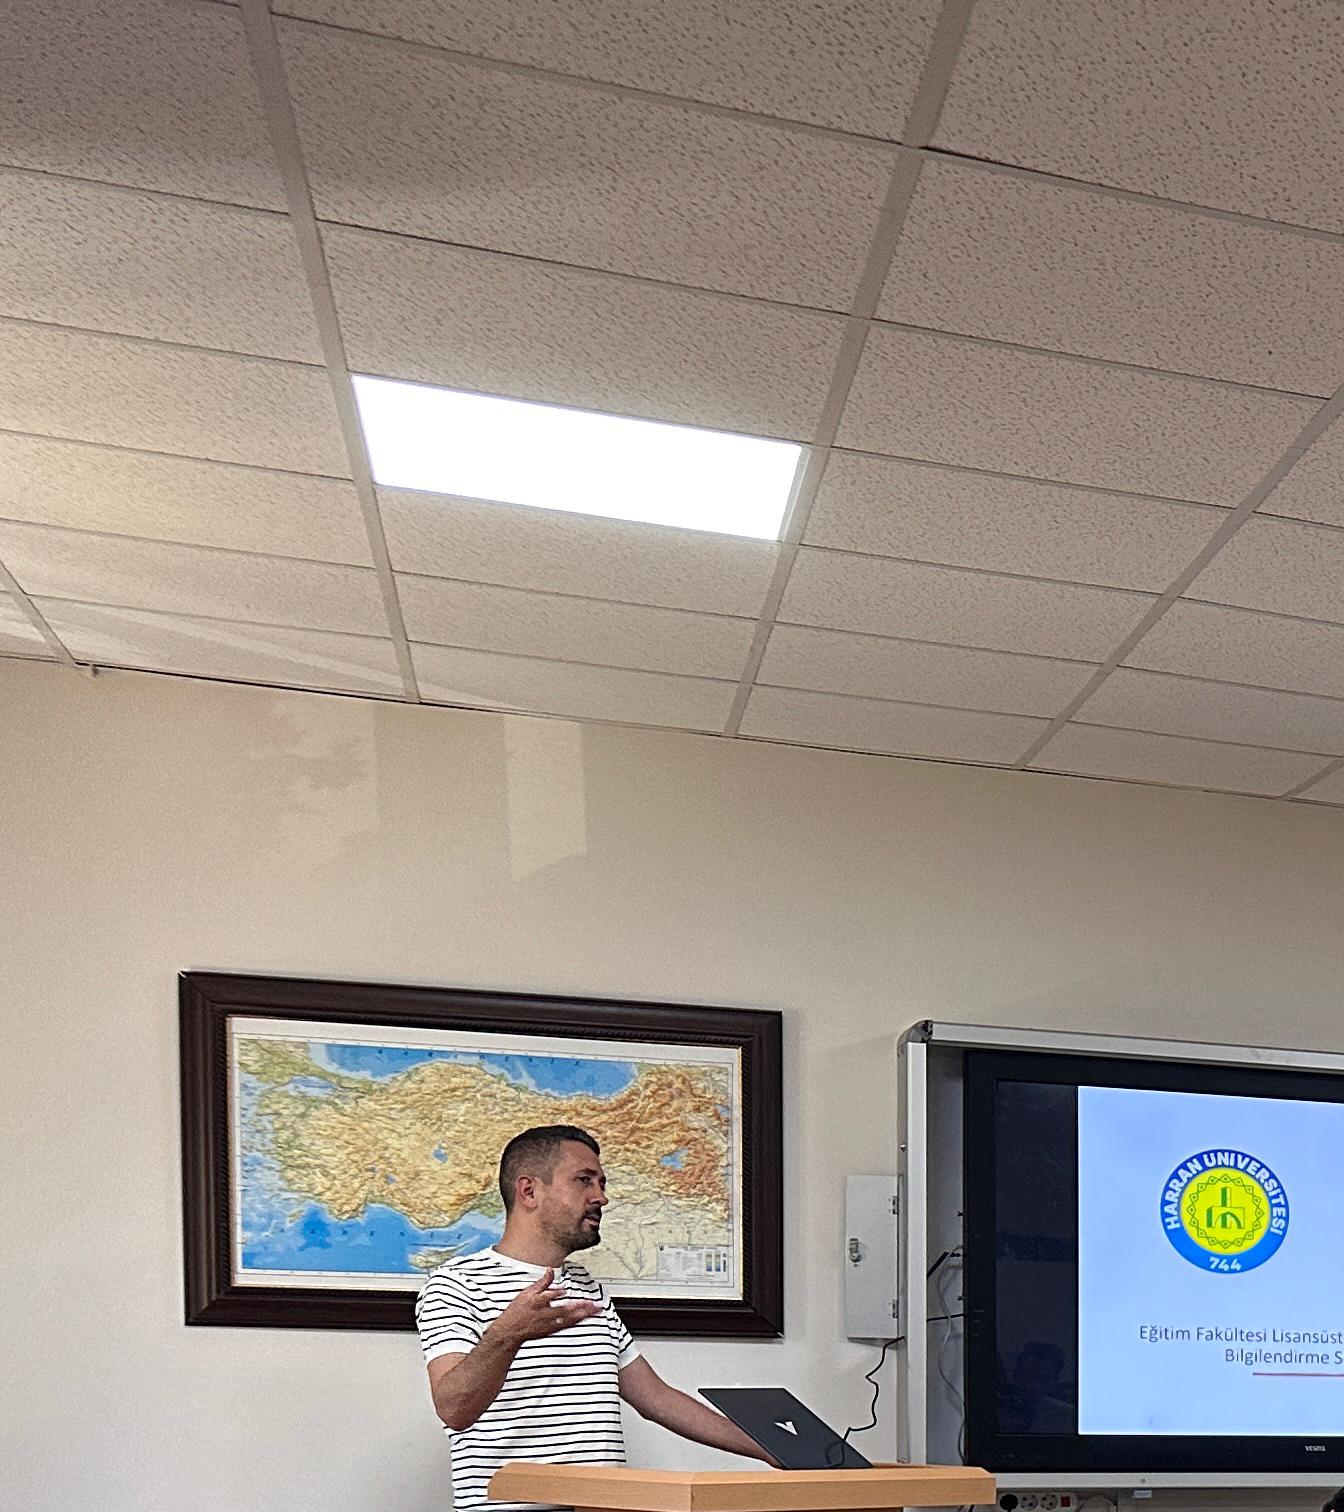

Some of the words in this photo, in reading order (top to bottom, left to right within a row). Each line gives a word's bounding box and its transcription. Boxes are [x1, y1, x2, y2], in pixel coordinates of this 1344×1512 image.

[1163, 1158, 1203, 1230] HARRAN
[1209, 1256, 1242, 1272] 744
[1139, 1324, 1191, 1343] Eğitim
[1196, 1326, 1267, 1343] Fakültesi
[1225, 1348, 1330, 1366] Bilgilendirme
